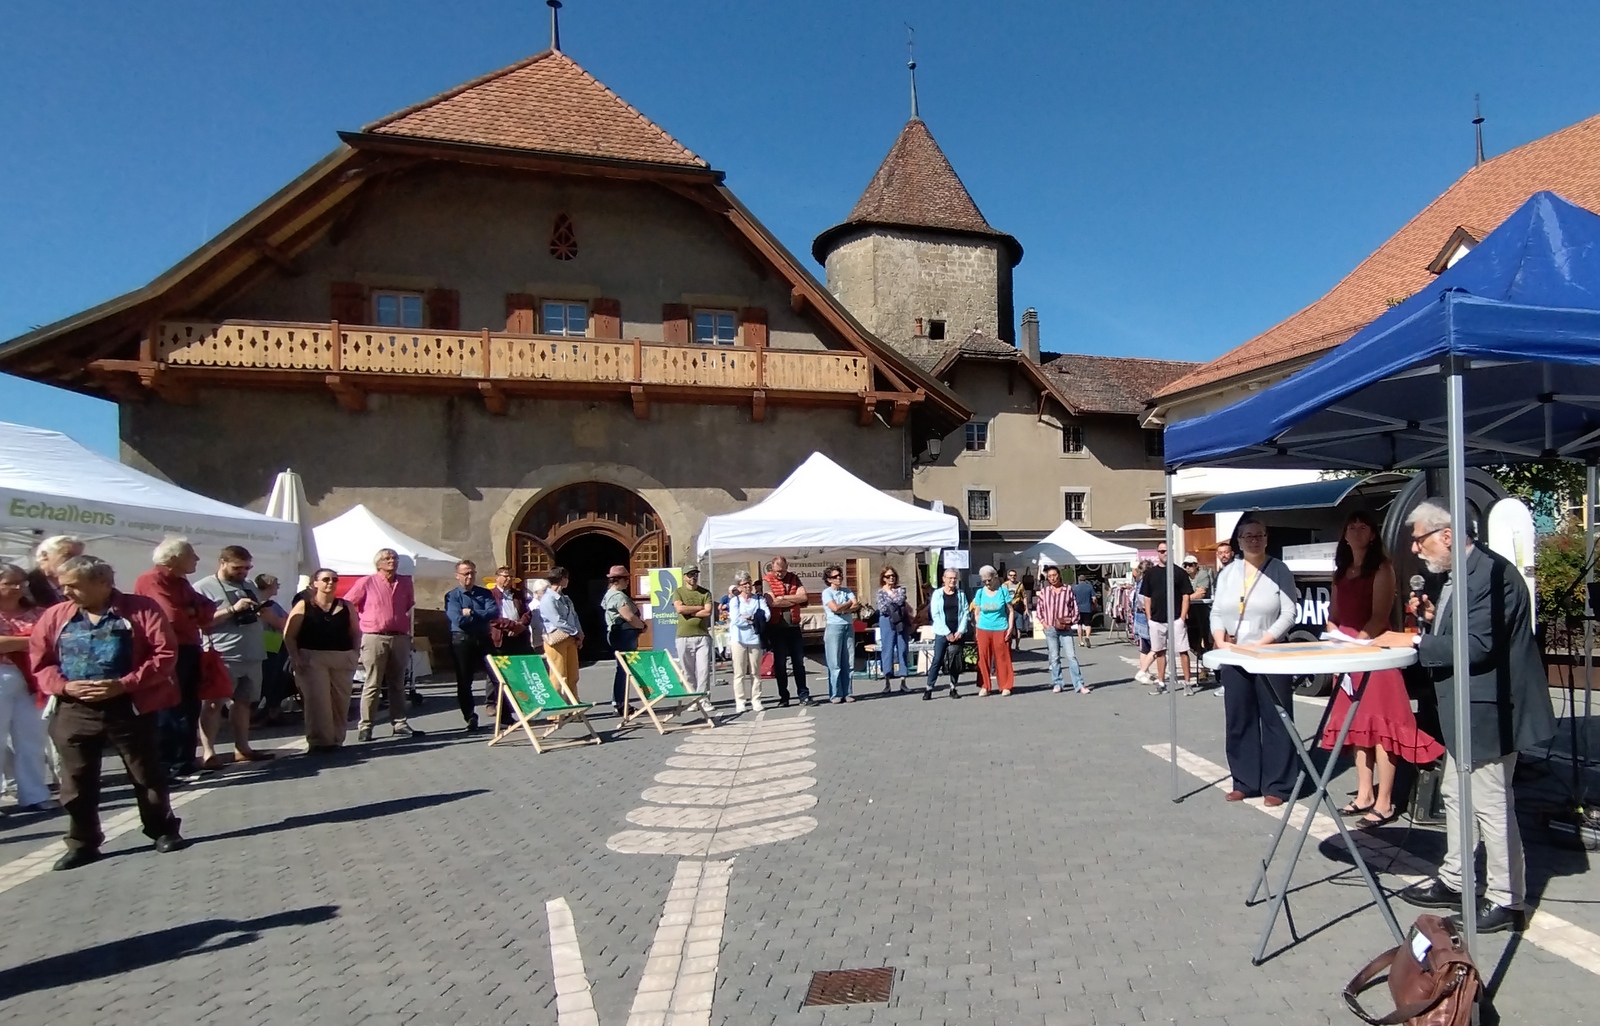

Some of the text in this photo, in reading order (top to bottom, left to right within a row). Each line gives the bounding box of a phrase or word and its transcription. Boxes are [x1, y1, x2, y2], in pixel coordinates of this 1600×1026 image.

[9, 498, 116, 526] Echallens
[787, 560, 844, 568] ermaculture
[529, 684, 546, 705] GROS
